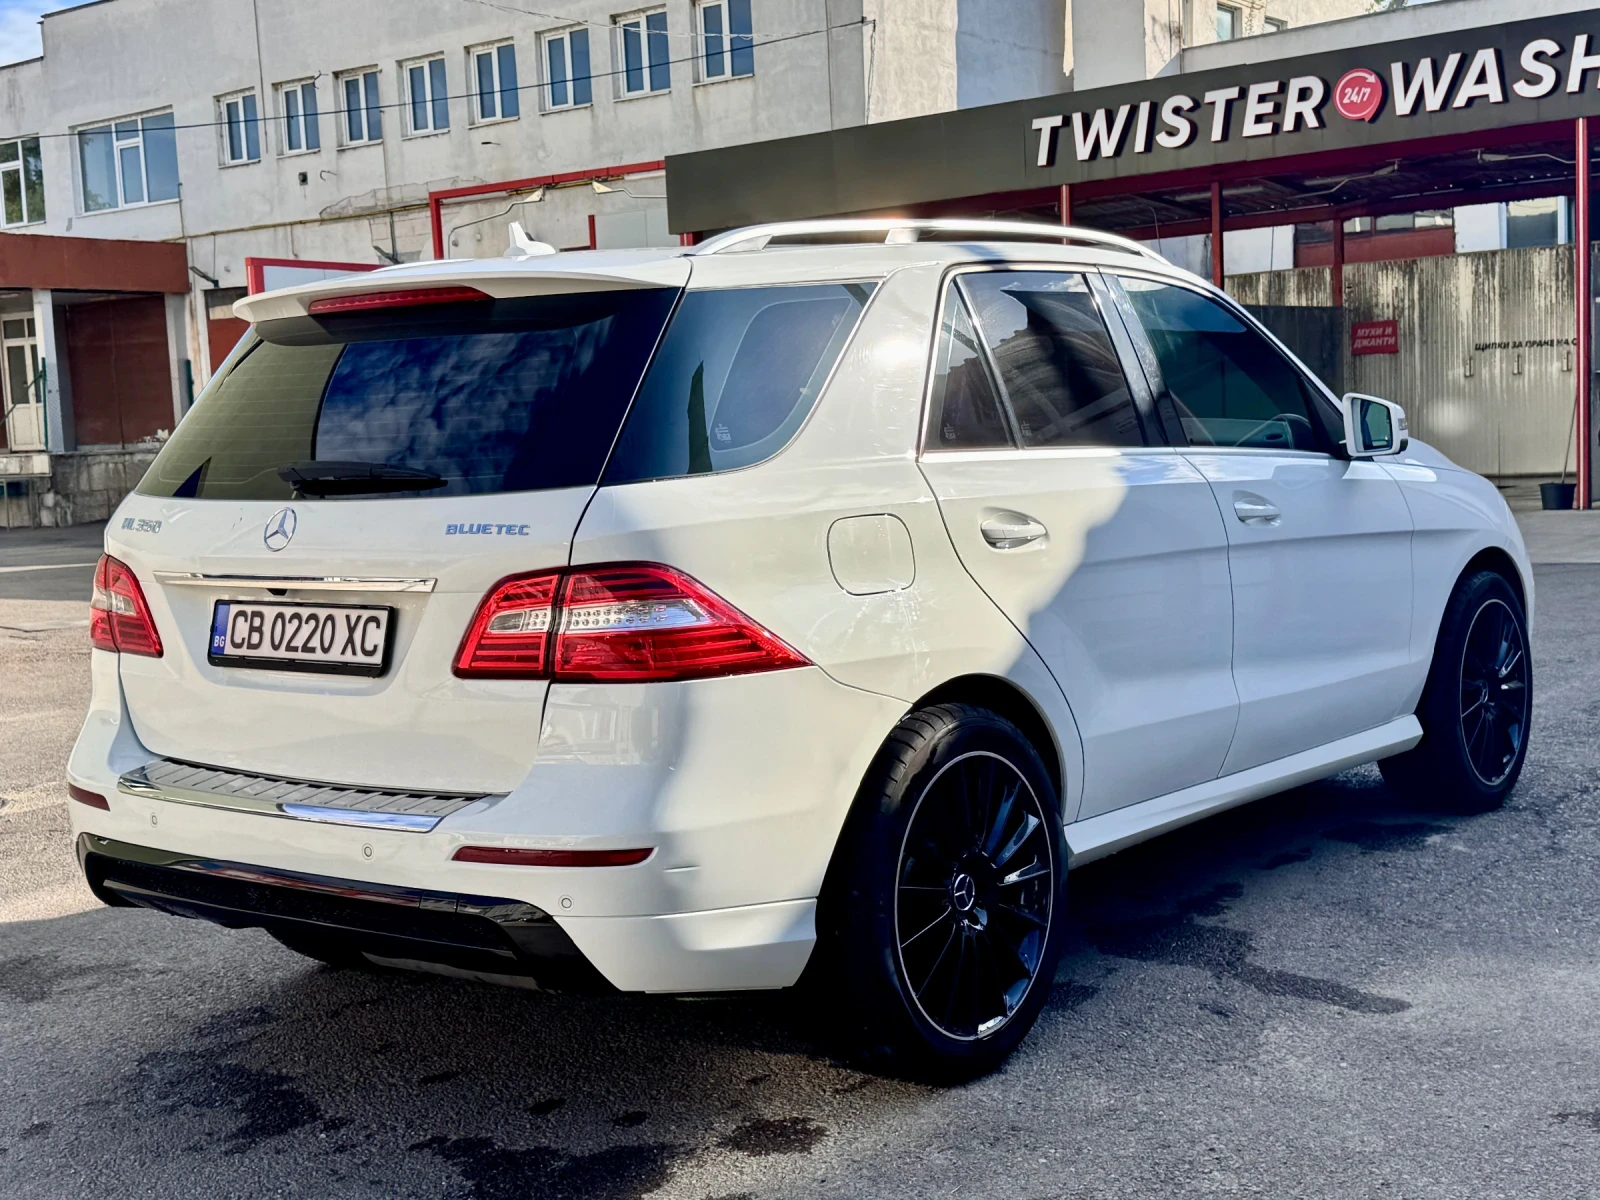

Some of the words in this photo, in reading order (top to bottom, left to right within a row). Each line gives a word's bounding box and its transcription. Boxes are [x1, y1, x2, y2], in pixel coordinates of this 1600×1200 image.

[1031, 75, 1326, 167] TWISTER
[1342, 86, 1372, 104] 24/7
[1390, 33, 1600, 117] WASH
[1353, 336, 1396, 349] ДЖАНТИ
[445, 523, 531, 536] BLUETEC
[230, 610, 265, 650] CB
[270, 611, 336, 655] 0220
[340, 614, 381, 657] XC
[213, 635, 226, 648] BG
